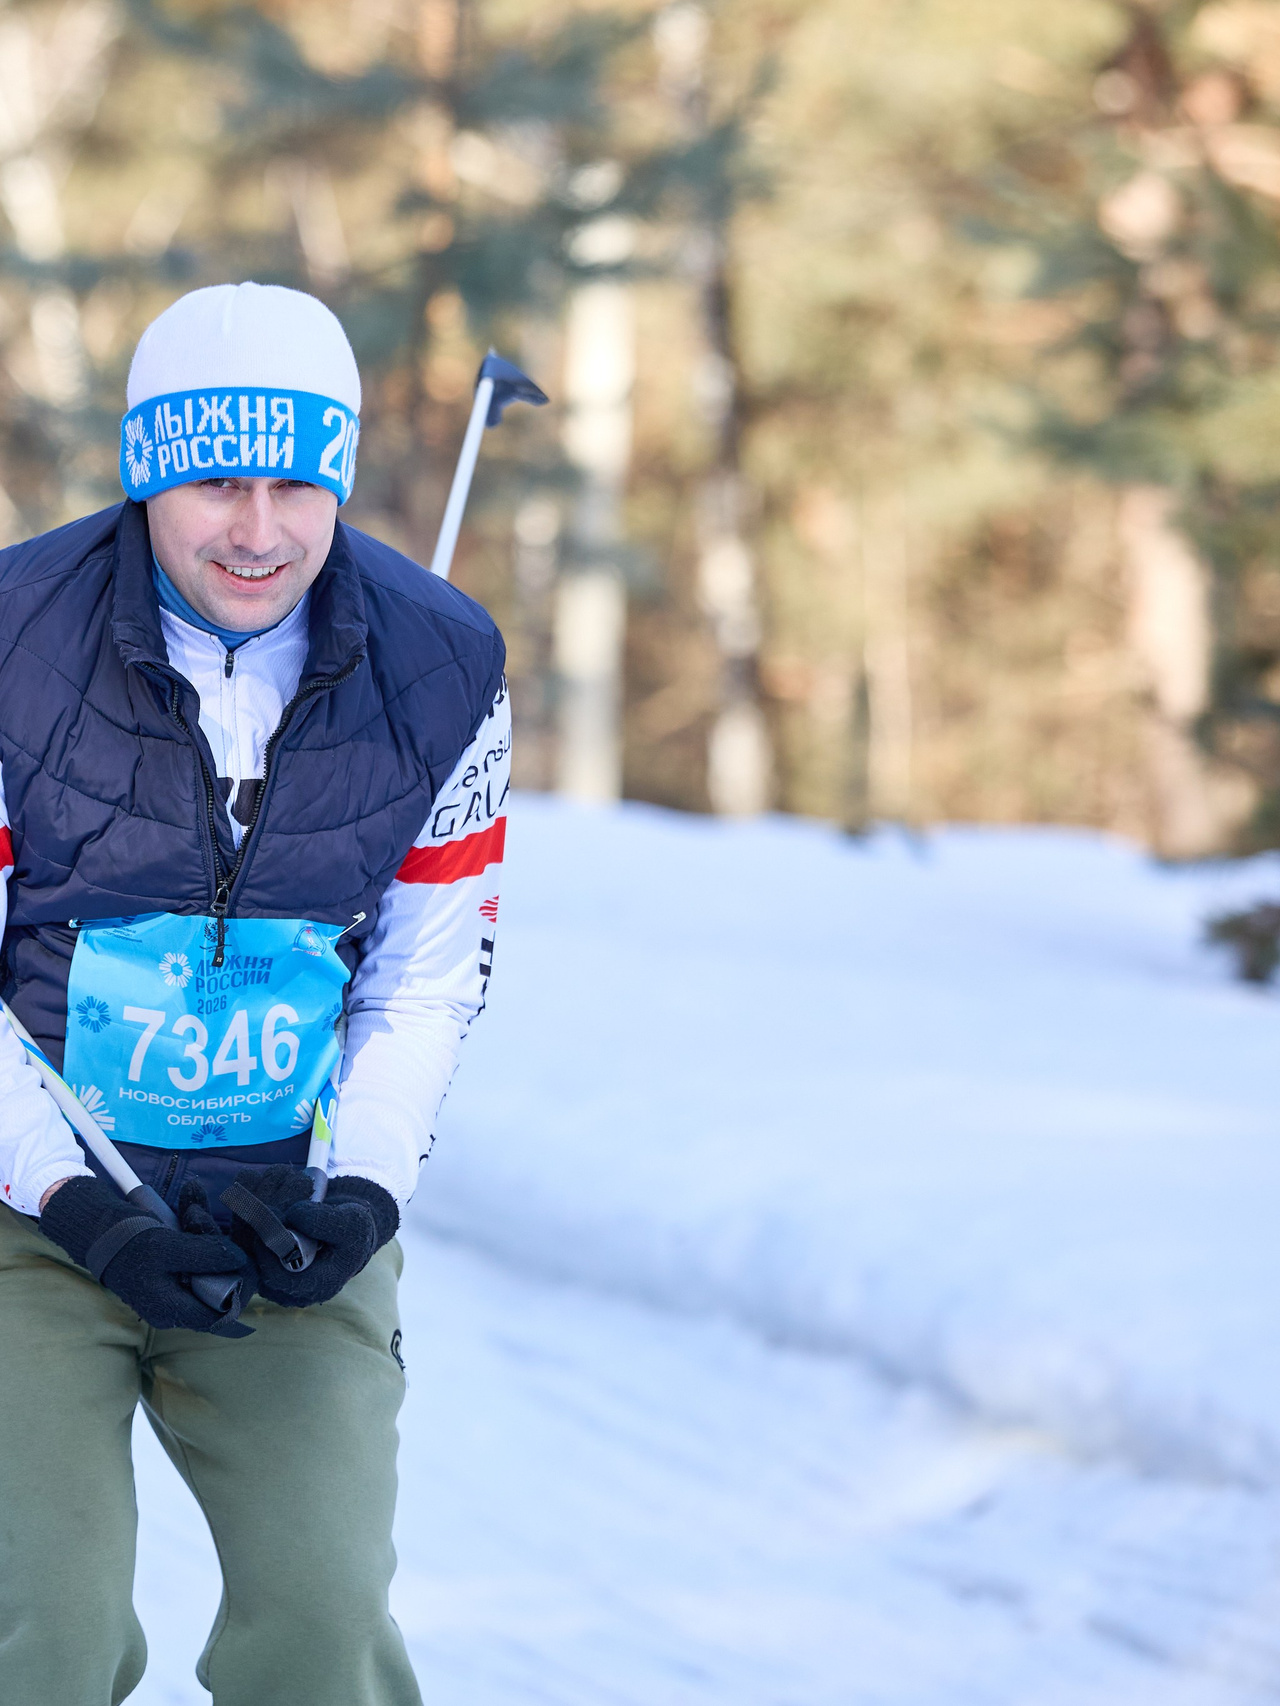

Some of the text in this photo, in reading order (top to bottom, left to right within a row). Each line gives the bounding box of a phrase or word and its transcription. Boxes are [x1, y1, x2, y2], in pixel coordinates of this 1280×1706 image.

[154, 395, 360, 499] ЛЫЖНЯ 20
[157, 433, 295, 478] РОССИИ
[195, 970, 271, 995] РОССИИ
[197, 995, 228, 1015] 2026
[122, 1003, 300, 1093] 7346
[119, 1083, 295, 1110] НОВОСИБИРСКАЯ
[167, 1112, 252, 1126] ОБЛАСТЬ
